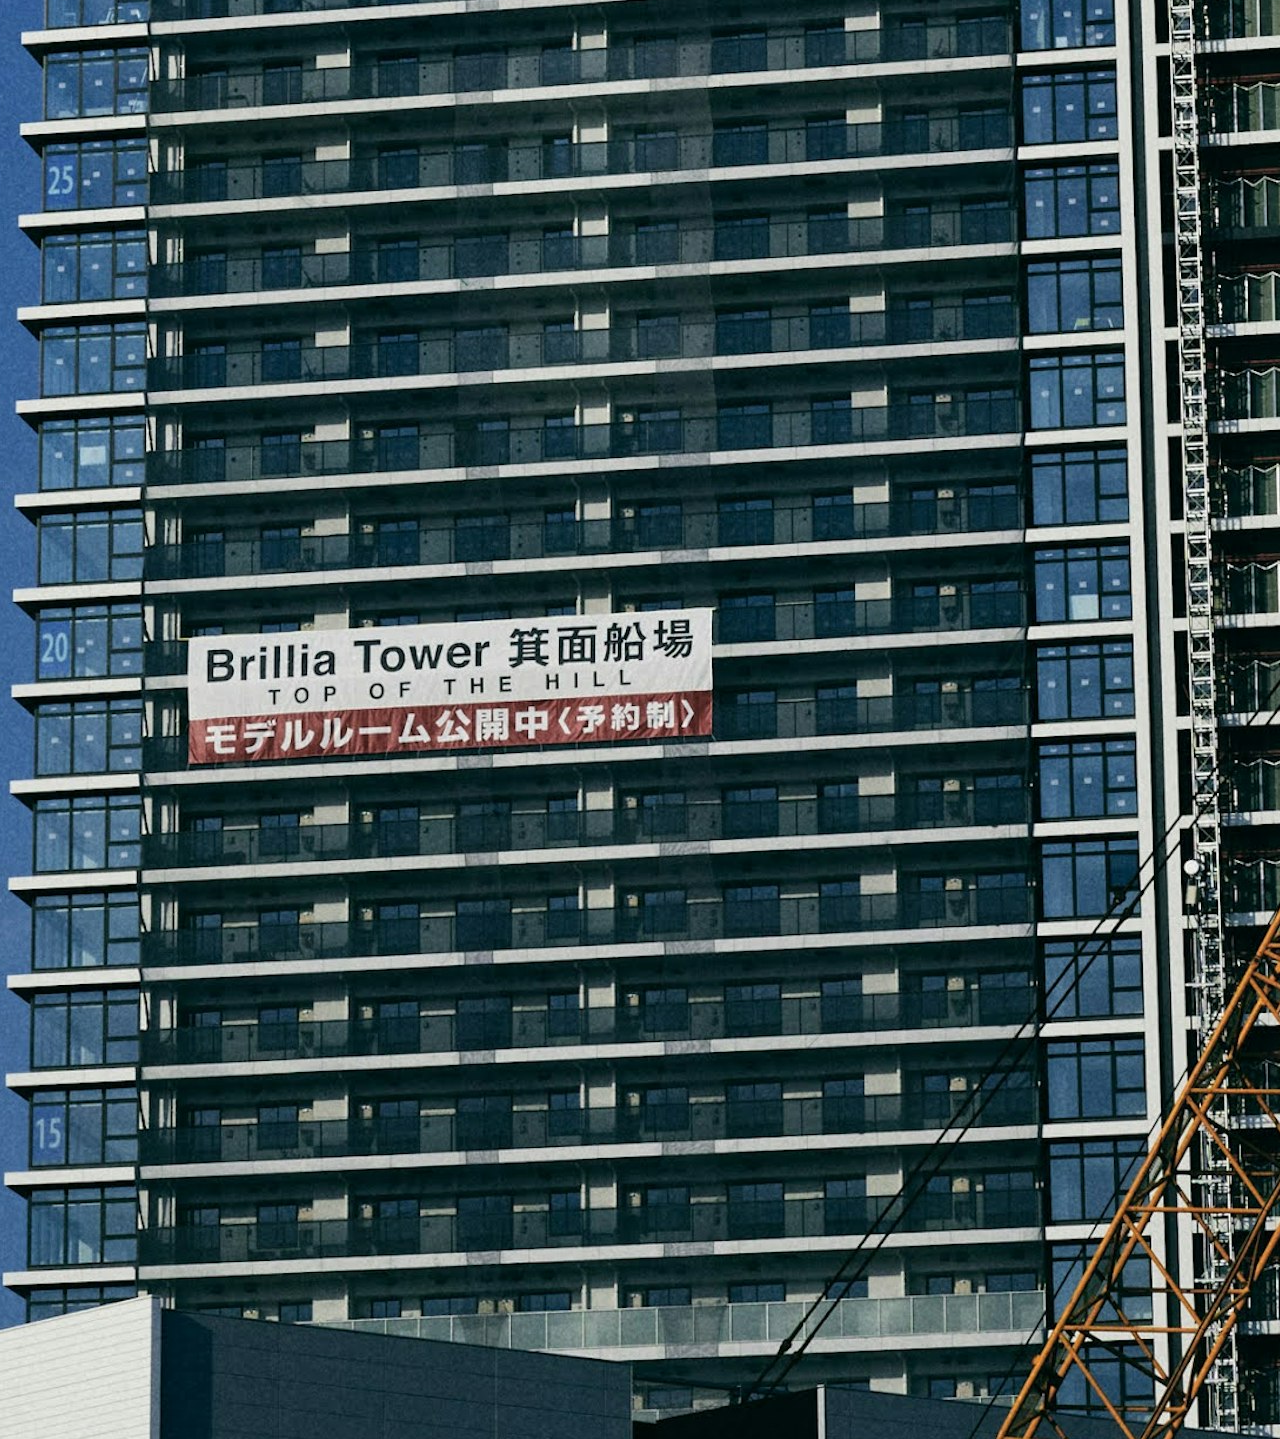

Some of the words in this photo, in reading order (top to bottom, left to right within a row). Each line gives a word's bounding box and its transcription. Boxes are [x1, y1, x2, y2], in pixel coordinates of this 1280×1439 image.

[48, 165, 74, 195] 25
[41, 631, 69, 663] 20
[207, 642, 336, 682] Brillia
[354, 639, 489, 673] Tower
[509, 620, 694, 668] 箕面船場
[269, 686, 337, 706] TOP
[369, 682, 413, 700] OF
[444, 675, 513, 697] THE
[546, 669, 631, 689] HILL
[37, 1117, 62, 1149] 15
